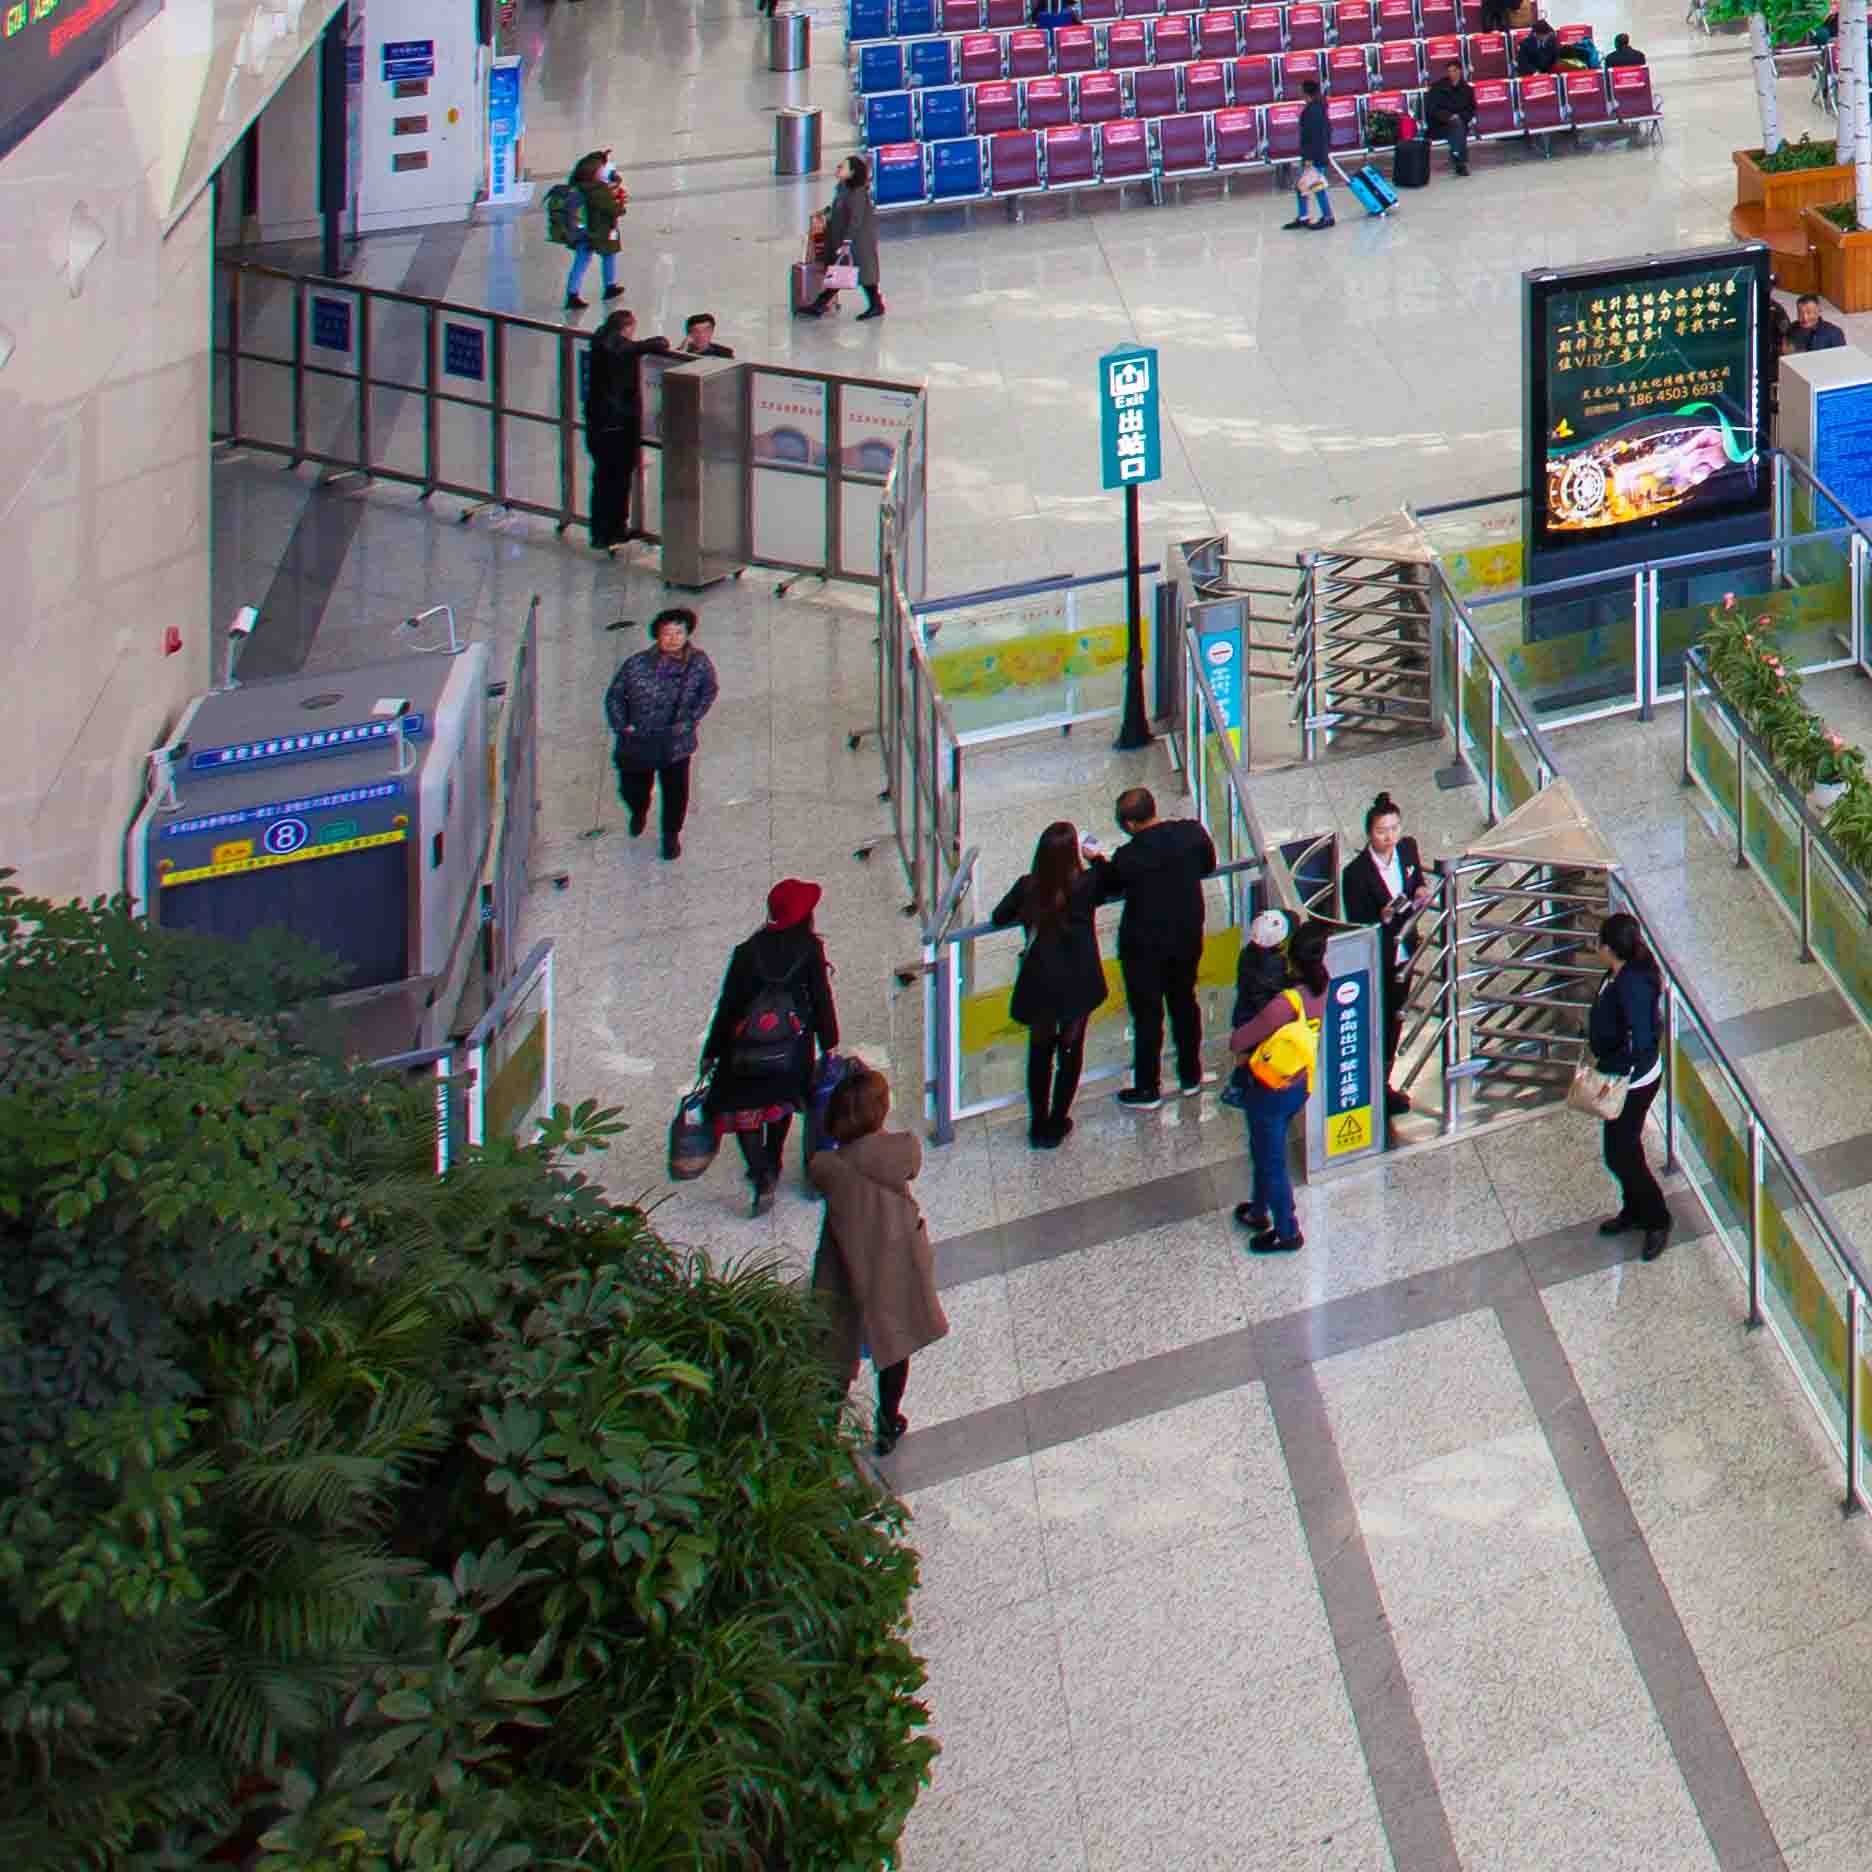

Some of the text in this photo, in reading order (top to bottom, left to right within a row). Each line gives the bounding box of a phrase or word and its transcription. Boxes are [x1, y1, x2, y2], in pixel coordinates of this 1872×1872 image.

[1114, 393, 1145, 409] Exit
[1629, 391, 1655, 408] 186
[1656, 385, 1689, 402] 4503
[1692, 380, 1725, 397] 6933
[1117, 409, 1147, 480] 出站口
[1338, 1060, 1360, 1110] 禁止通行
